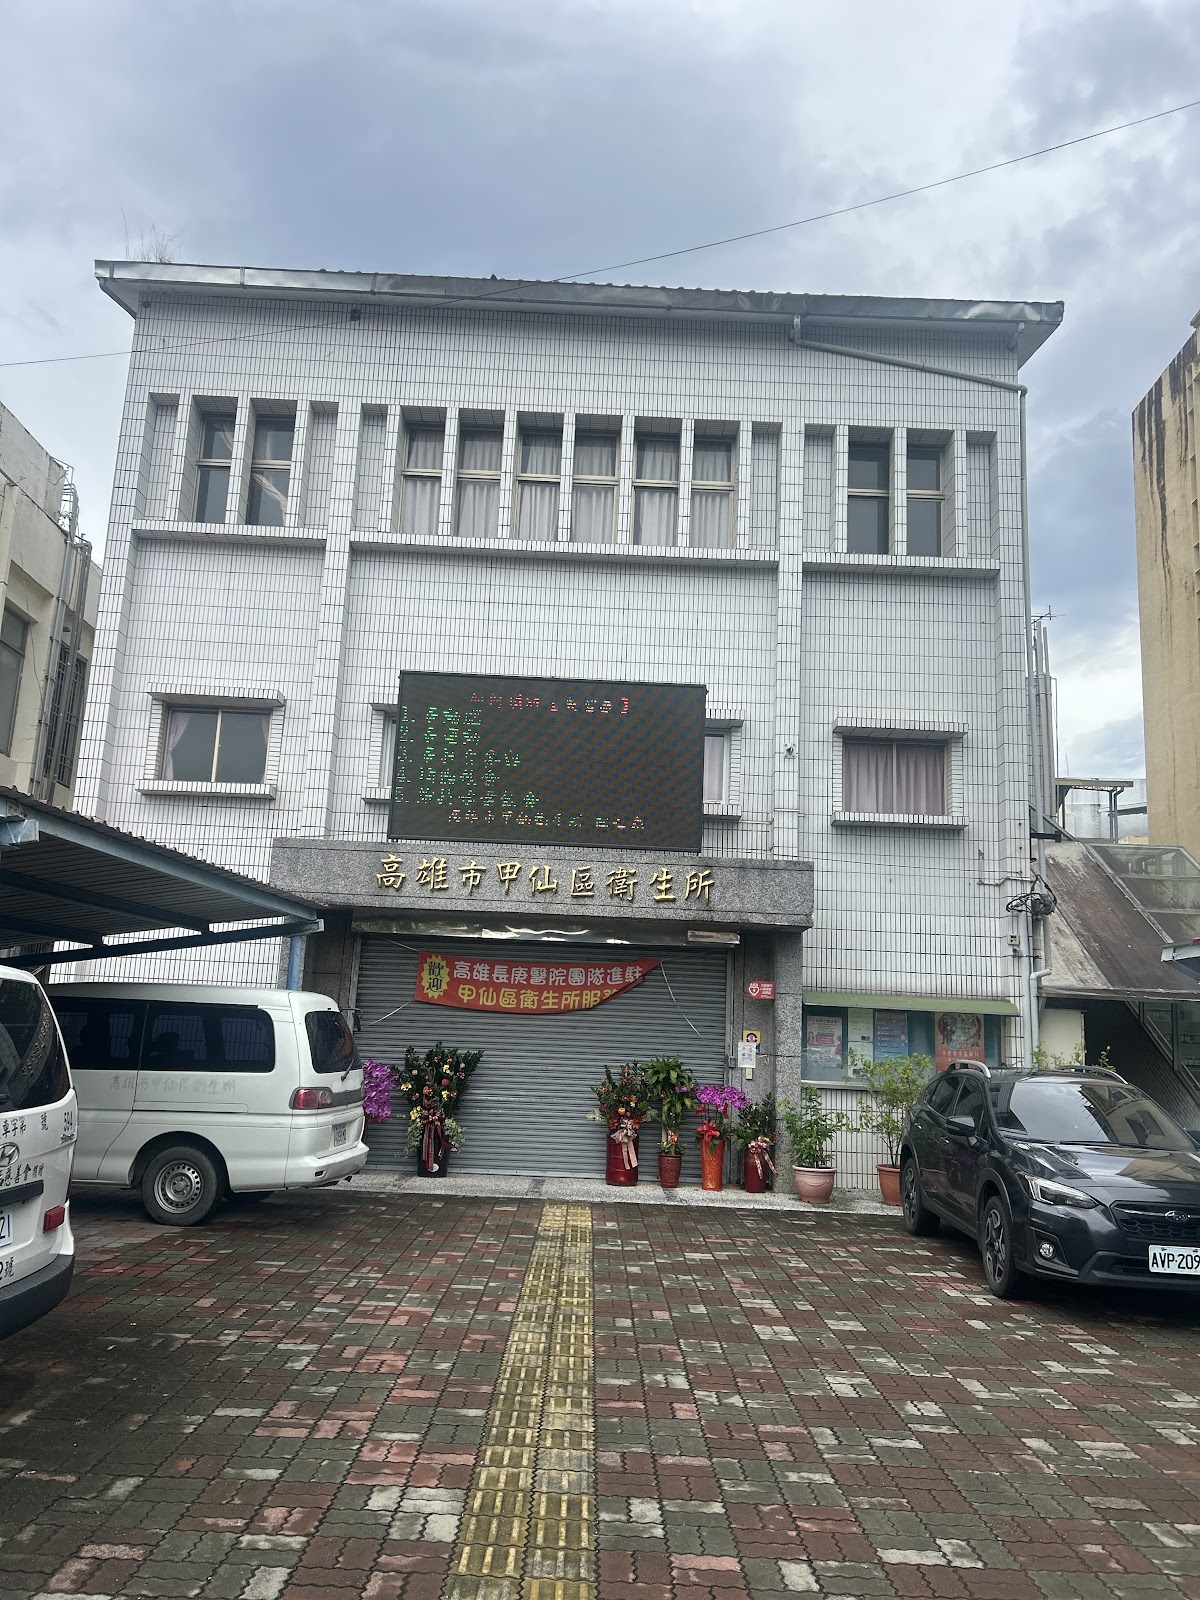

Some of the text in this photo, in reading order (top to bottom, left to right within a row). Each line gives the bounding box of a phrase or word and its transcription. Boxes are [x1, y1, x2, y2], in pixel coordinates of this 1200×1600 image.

[376, 854, 715, 904] 高雄市甲仙區衛生所
[426, 961, 444, 993] 歡迎
[453, 961, 643, 986] 高雄長庚醫院團隊進駐
[0, 1116, 26, 1139] 車字第
